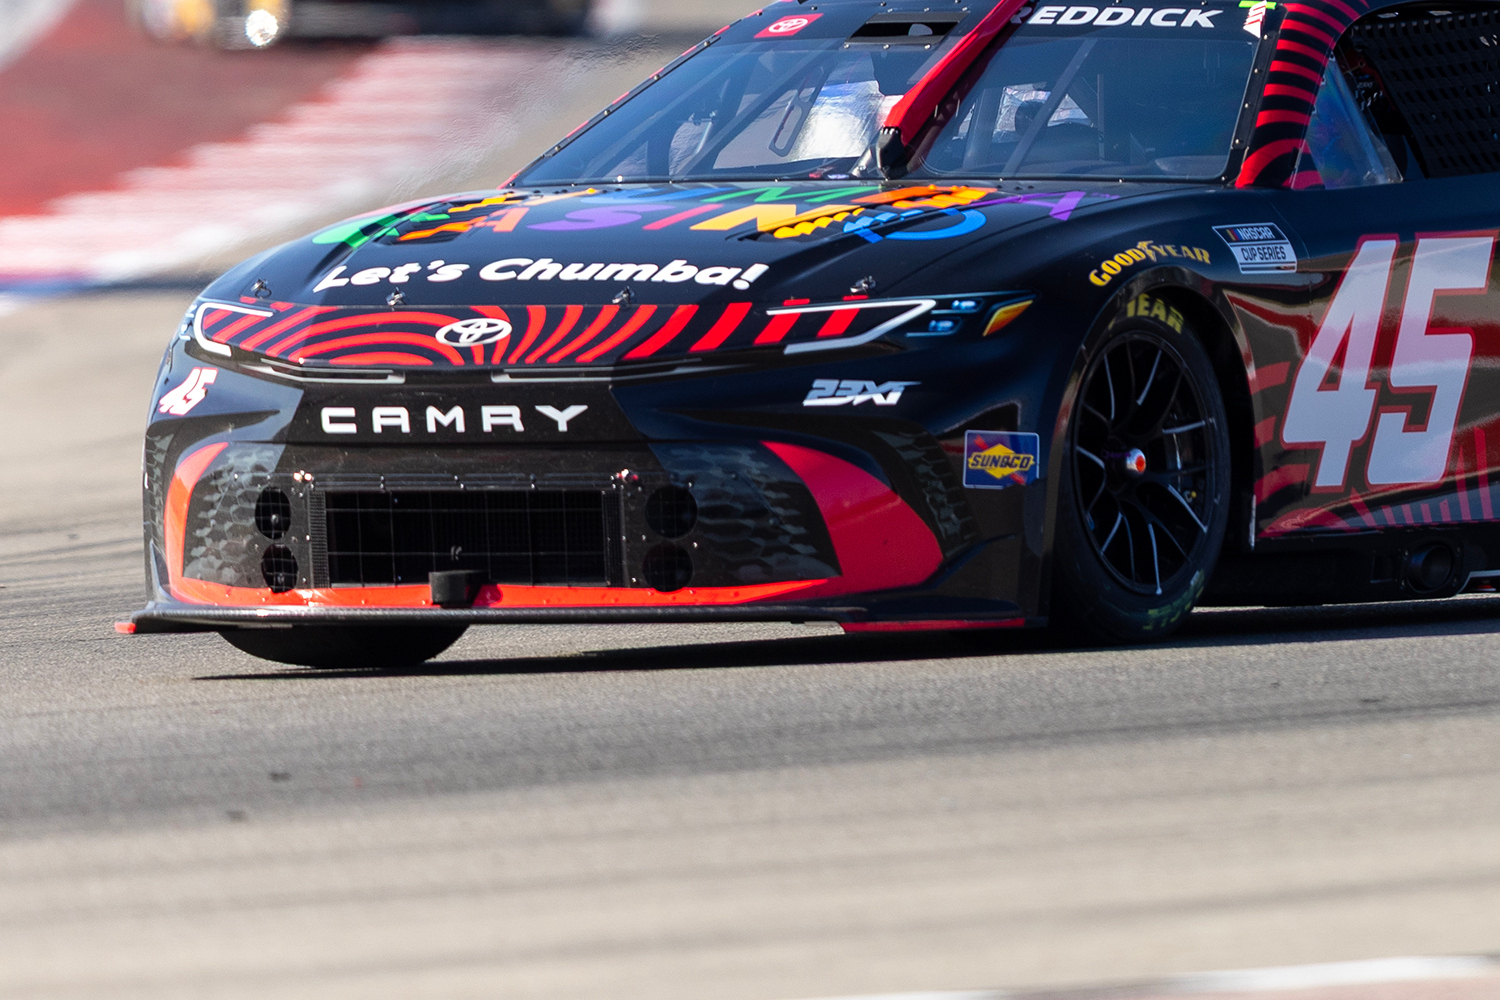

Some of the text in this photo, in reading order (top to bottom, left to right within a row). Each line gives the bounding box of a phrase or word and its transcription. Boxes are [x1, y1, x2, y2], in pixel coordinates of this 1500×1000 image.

[1237, 226, 1276, 240] NASCAR
[1089, 240, 1211, 287] GOODYEAR
[1241, 245, 1287, 261] CUP SERIES
[312, 257, 770, 293] Let's Chumba!
[1283, 235, 1496, 489] 45
[159, 367, 218, 416] 45
[320, 404, 589, 434] CAMRY
[971, 454, 1032, 469] SUNOCO
